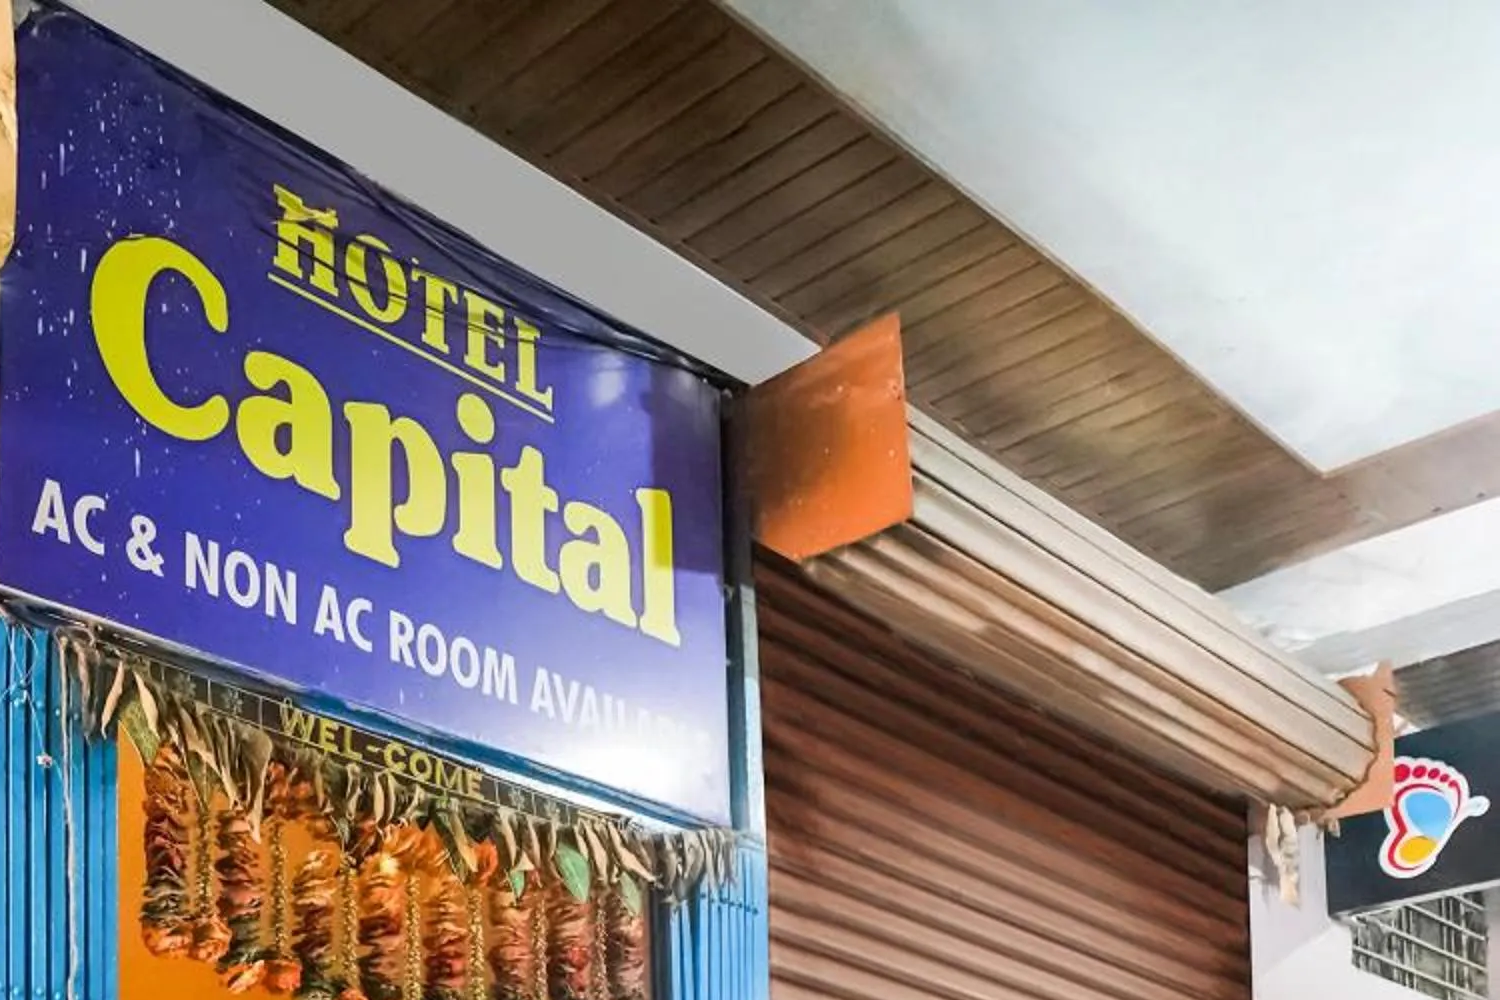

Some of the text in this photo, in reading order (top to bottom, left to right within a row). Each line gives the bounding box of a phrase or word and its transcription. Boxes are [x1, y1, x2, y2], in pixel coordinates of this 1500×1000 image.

[273, 184, 554, 411] HOTEL
[90, 234, 681, 648] Capital
[32, 478, 106, 557] AC
[125, 514, 164, 575] &
[184, 530, 298, 625] NON
[314, 585, 374, 652] AC
[390, 611, 519, 706] ROOM
[279, 703, 484, 800] WEL-COME
